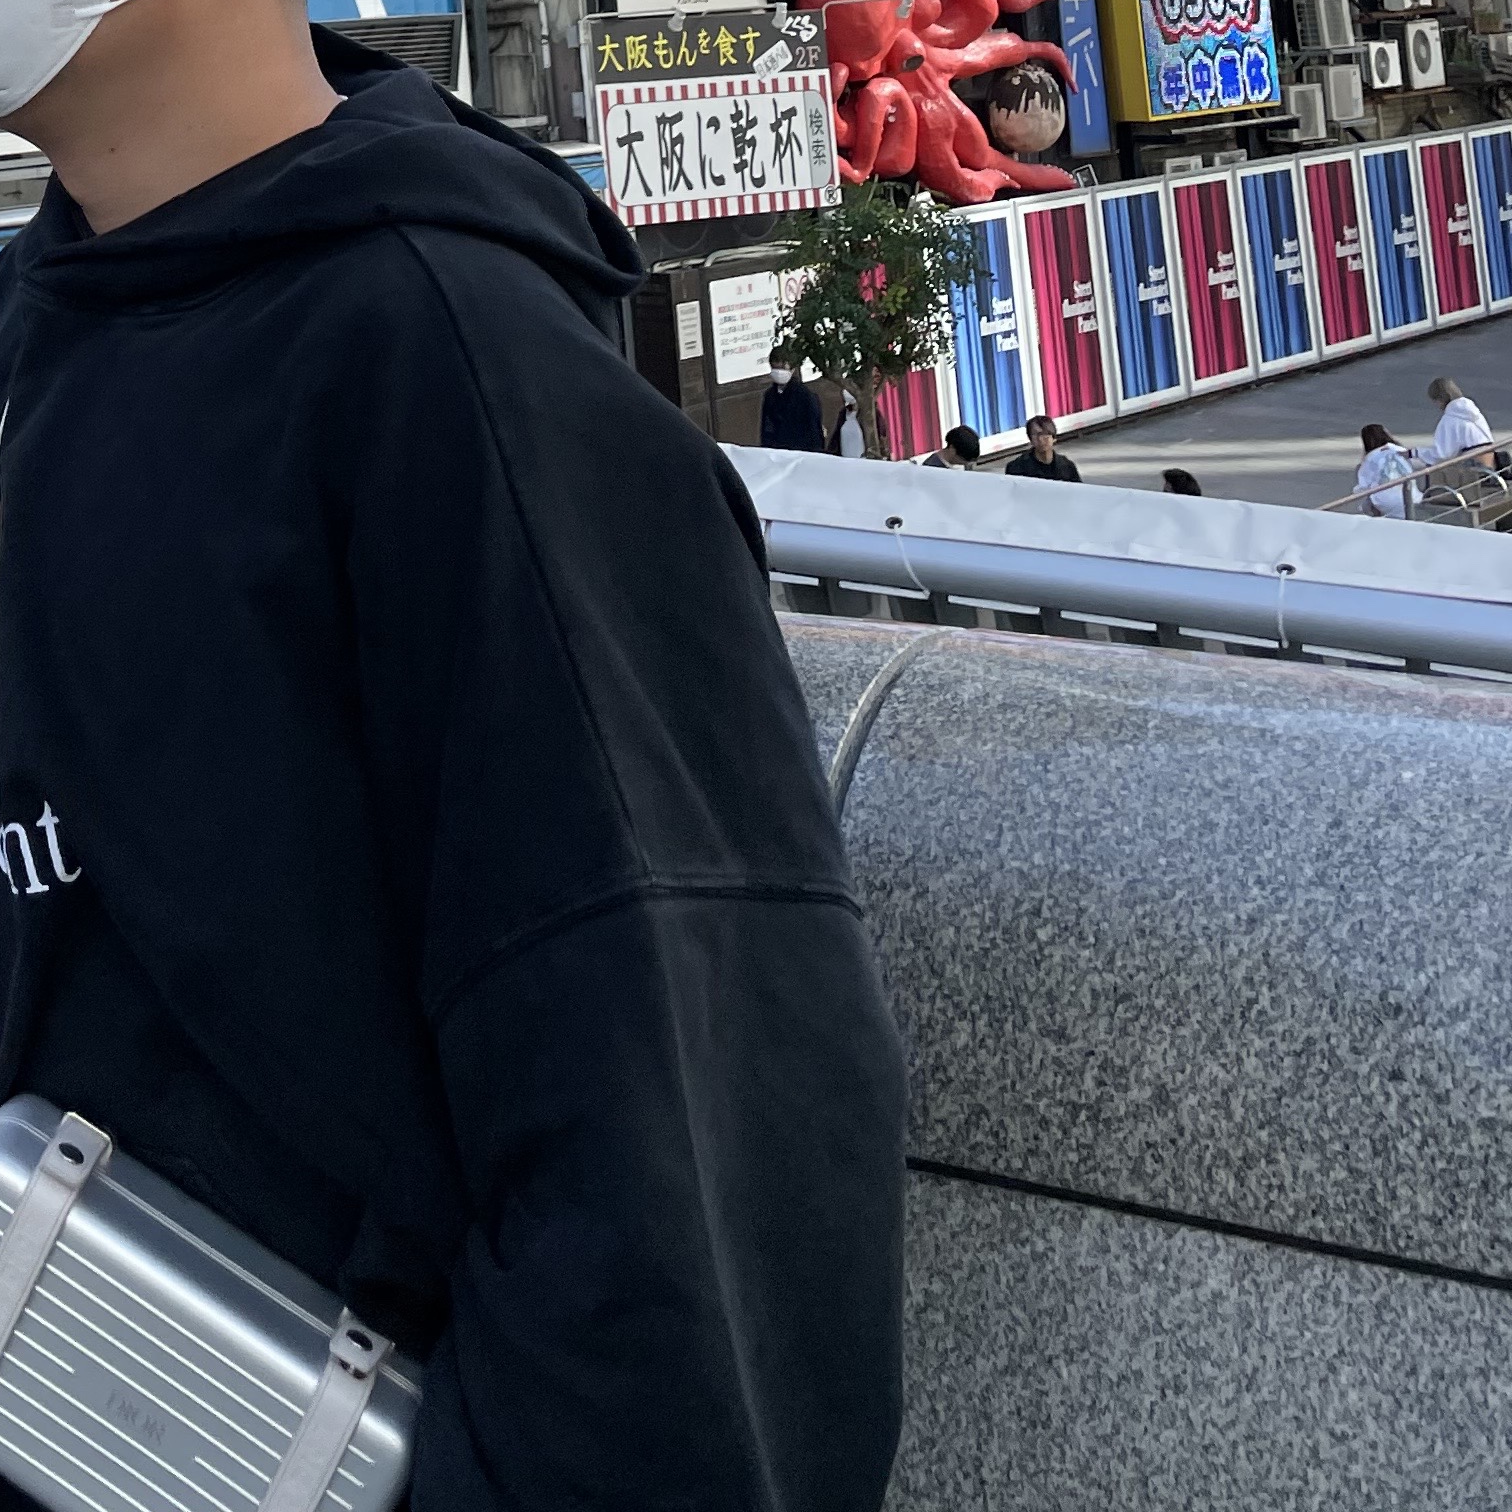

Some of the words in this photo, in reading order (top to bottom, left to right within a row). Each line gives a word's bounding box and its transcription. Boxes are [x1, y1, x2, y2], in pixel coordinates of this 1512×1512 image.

[597, 25, 761, 72] 大阪もんを食す
[781, 15, 818, 43] くくる
[795, 45, 822, 69] 2F
[616, 97, 803, 201] 大阪に乾杯
[808, 107, 827, 165] 検索
